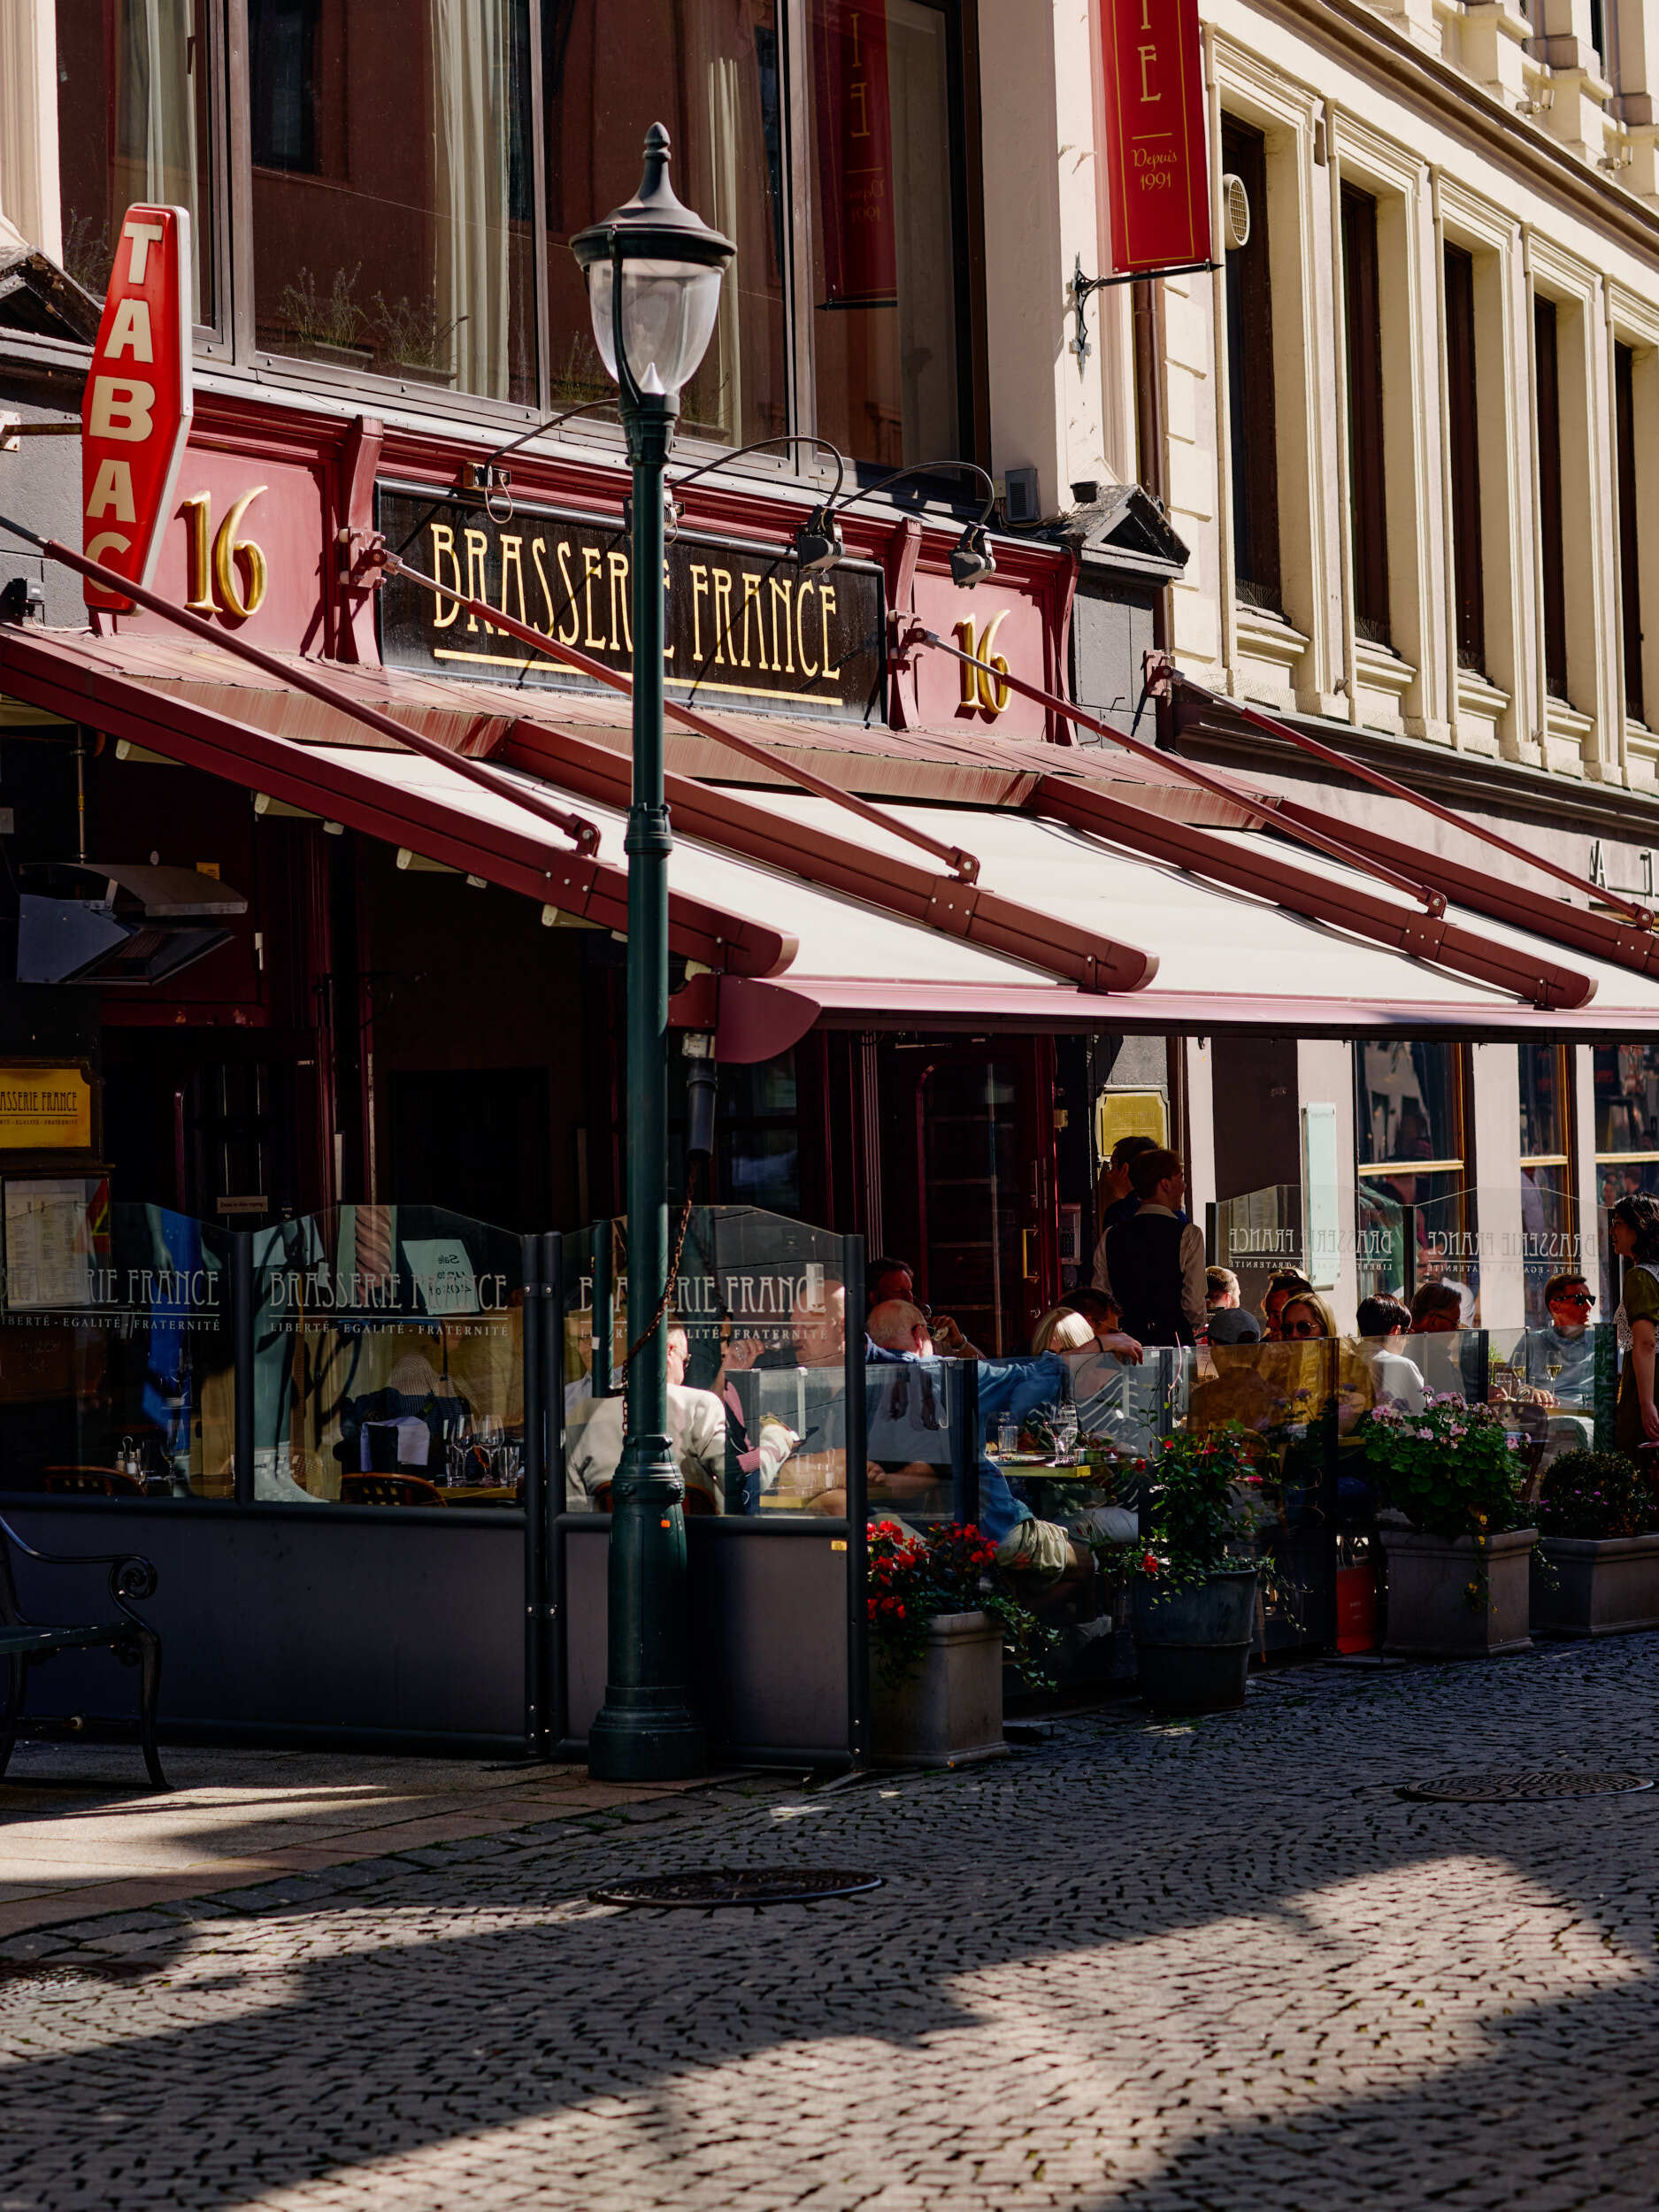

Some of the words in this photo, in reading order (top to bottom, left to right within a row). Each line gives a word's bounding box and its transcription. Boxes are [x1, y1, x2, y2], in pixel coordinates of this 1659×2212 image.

[1132, 148, 1178, 171] Depuis
[1141, 172, 1171, 190] 1991
[86, 221, 163, 594] TABAC
[184, 485, 268, 617] 16
[430, 523, 674, 658] BRASSER
[689, 565, 841, 680] FRANCE
[956, 609, 1012, 714] 16
[42, 1092, 78, 1111] FRANCE
[127, 1269, 220, 1306] FRANCE
[269, 1271, 402, 1310] BRASSERIE
[63, 1317, 121, 1328] EGALITÉ
[134, 1318, 220, 1332] FRATERNITÉ
[271, 1321, 330, 1333] LIBERTÉ
[343, 1322, 404, 1334] EGALITÉ
[419, 1324, 509, 1337] FRATERNITÉ
[734, 1328, 827, 1340] FRATERNITÉ
